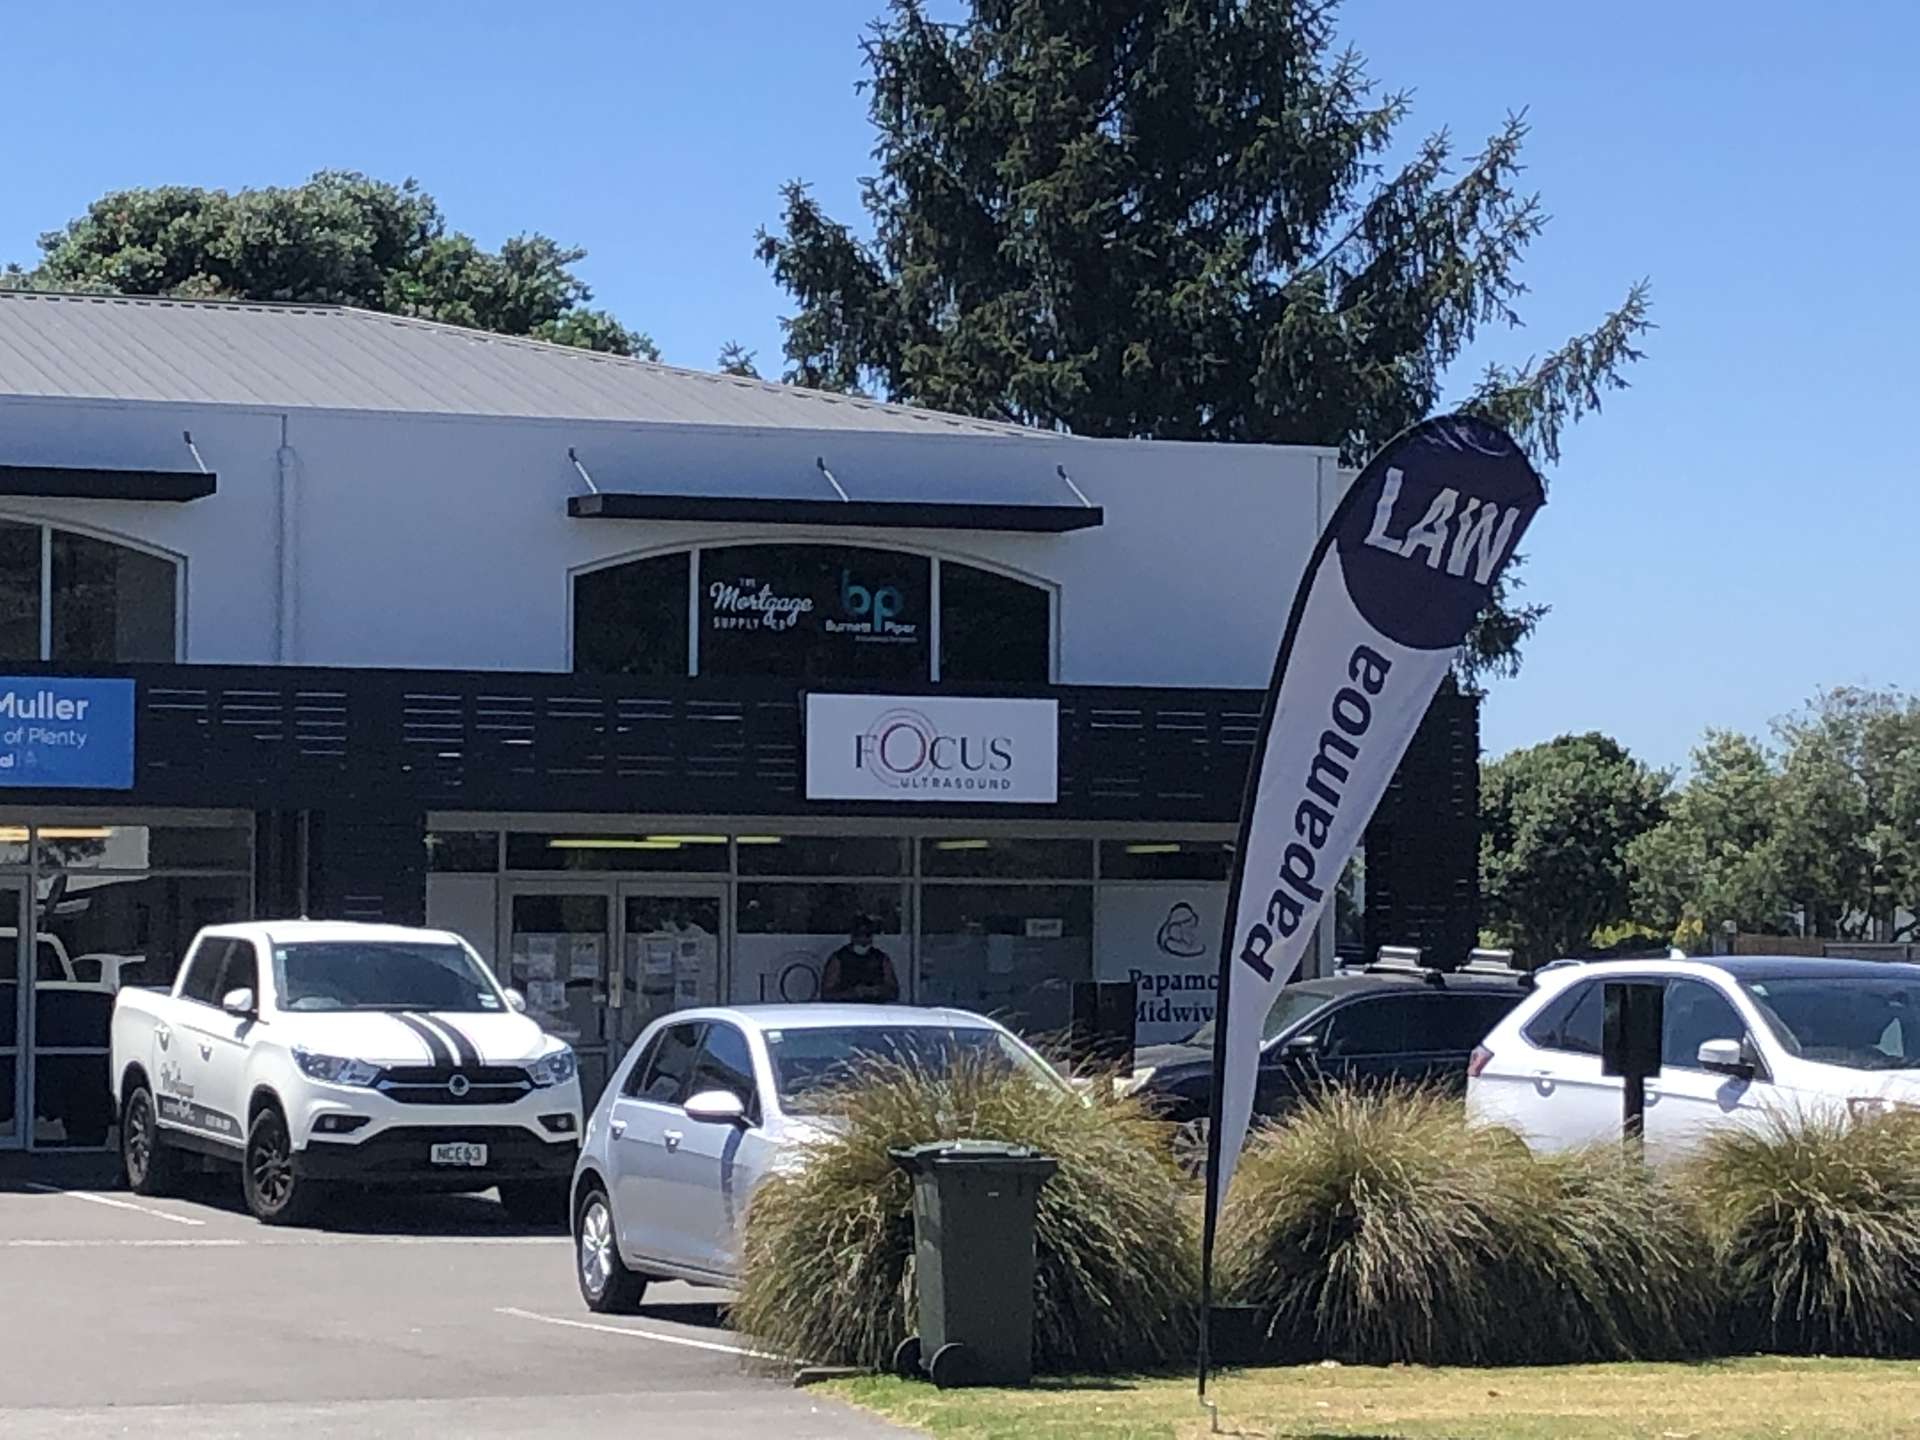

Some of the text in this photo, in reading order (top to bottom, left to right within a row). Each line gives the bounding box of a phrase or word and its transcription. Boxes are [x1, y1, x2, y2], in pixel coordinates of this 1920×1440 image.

[1364, 467, 1519, 585] LAW
[710, 581, 813, 627] Mortgage
[713, 616, 760, 630] SUPPLY
[4, 726, 88, 749] of Plenty
[900, 776, 1012, 790] ULTRASOUND
[1240, 644, 1392, 981] Papamoa
[1128, 969, 1220, 997] Papamo
[1136, 998, 1215, 1022] idwiv
